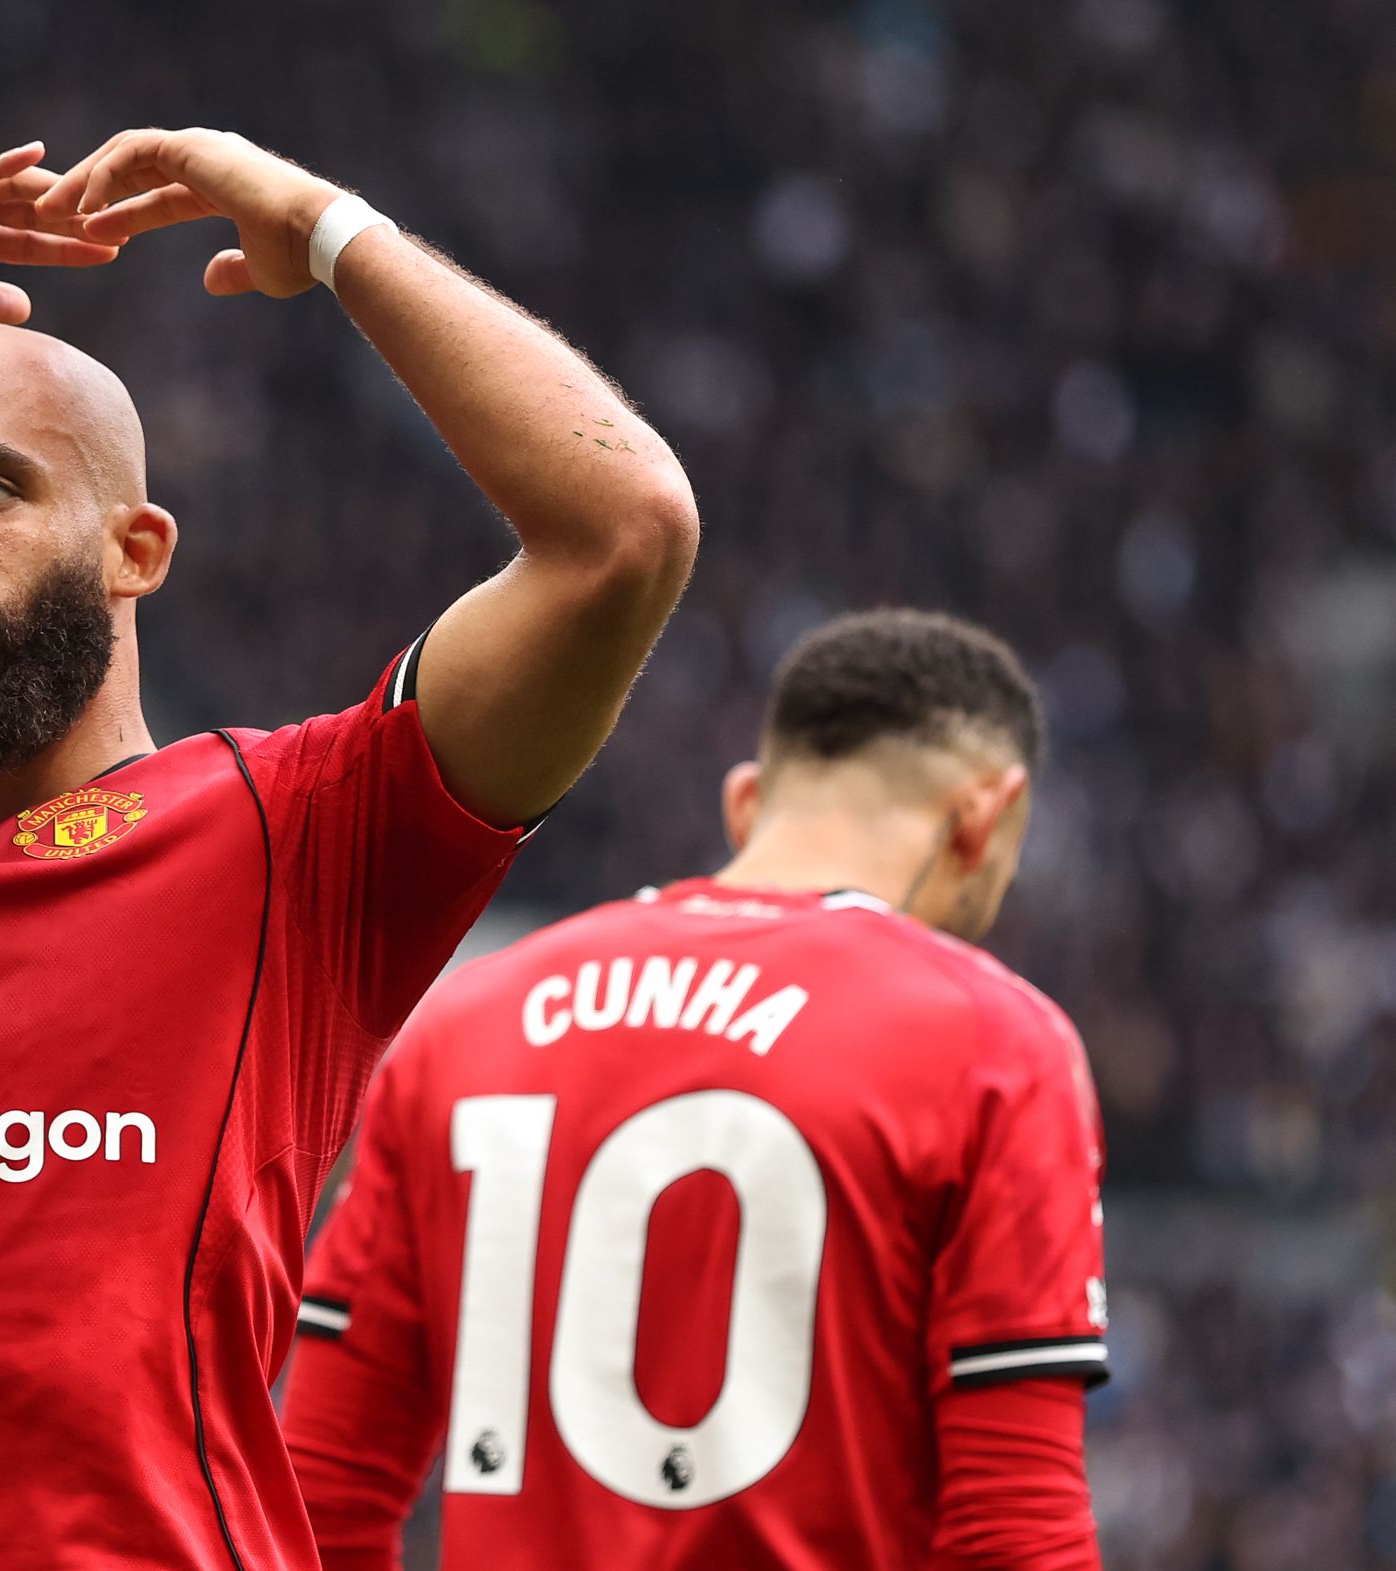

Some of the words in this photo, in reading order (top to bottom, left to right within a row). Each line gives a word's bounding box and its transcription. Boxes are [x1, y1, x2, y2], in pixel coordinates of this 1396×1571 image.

[27, 793, 134, 827] MANCHESTER
[45, 835, 118, 857] UNITED
[521, 956, 810, 1056] CUNHA
[444, 1088, 827, 1511] 10
